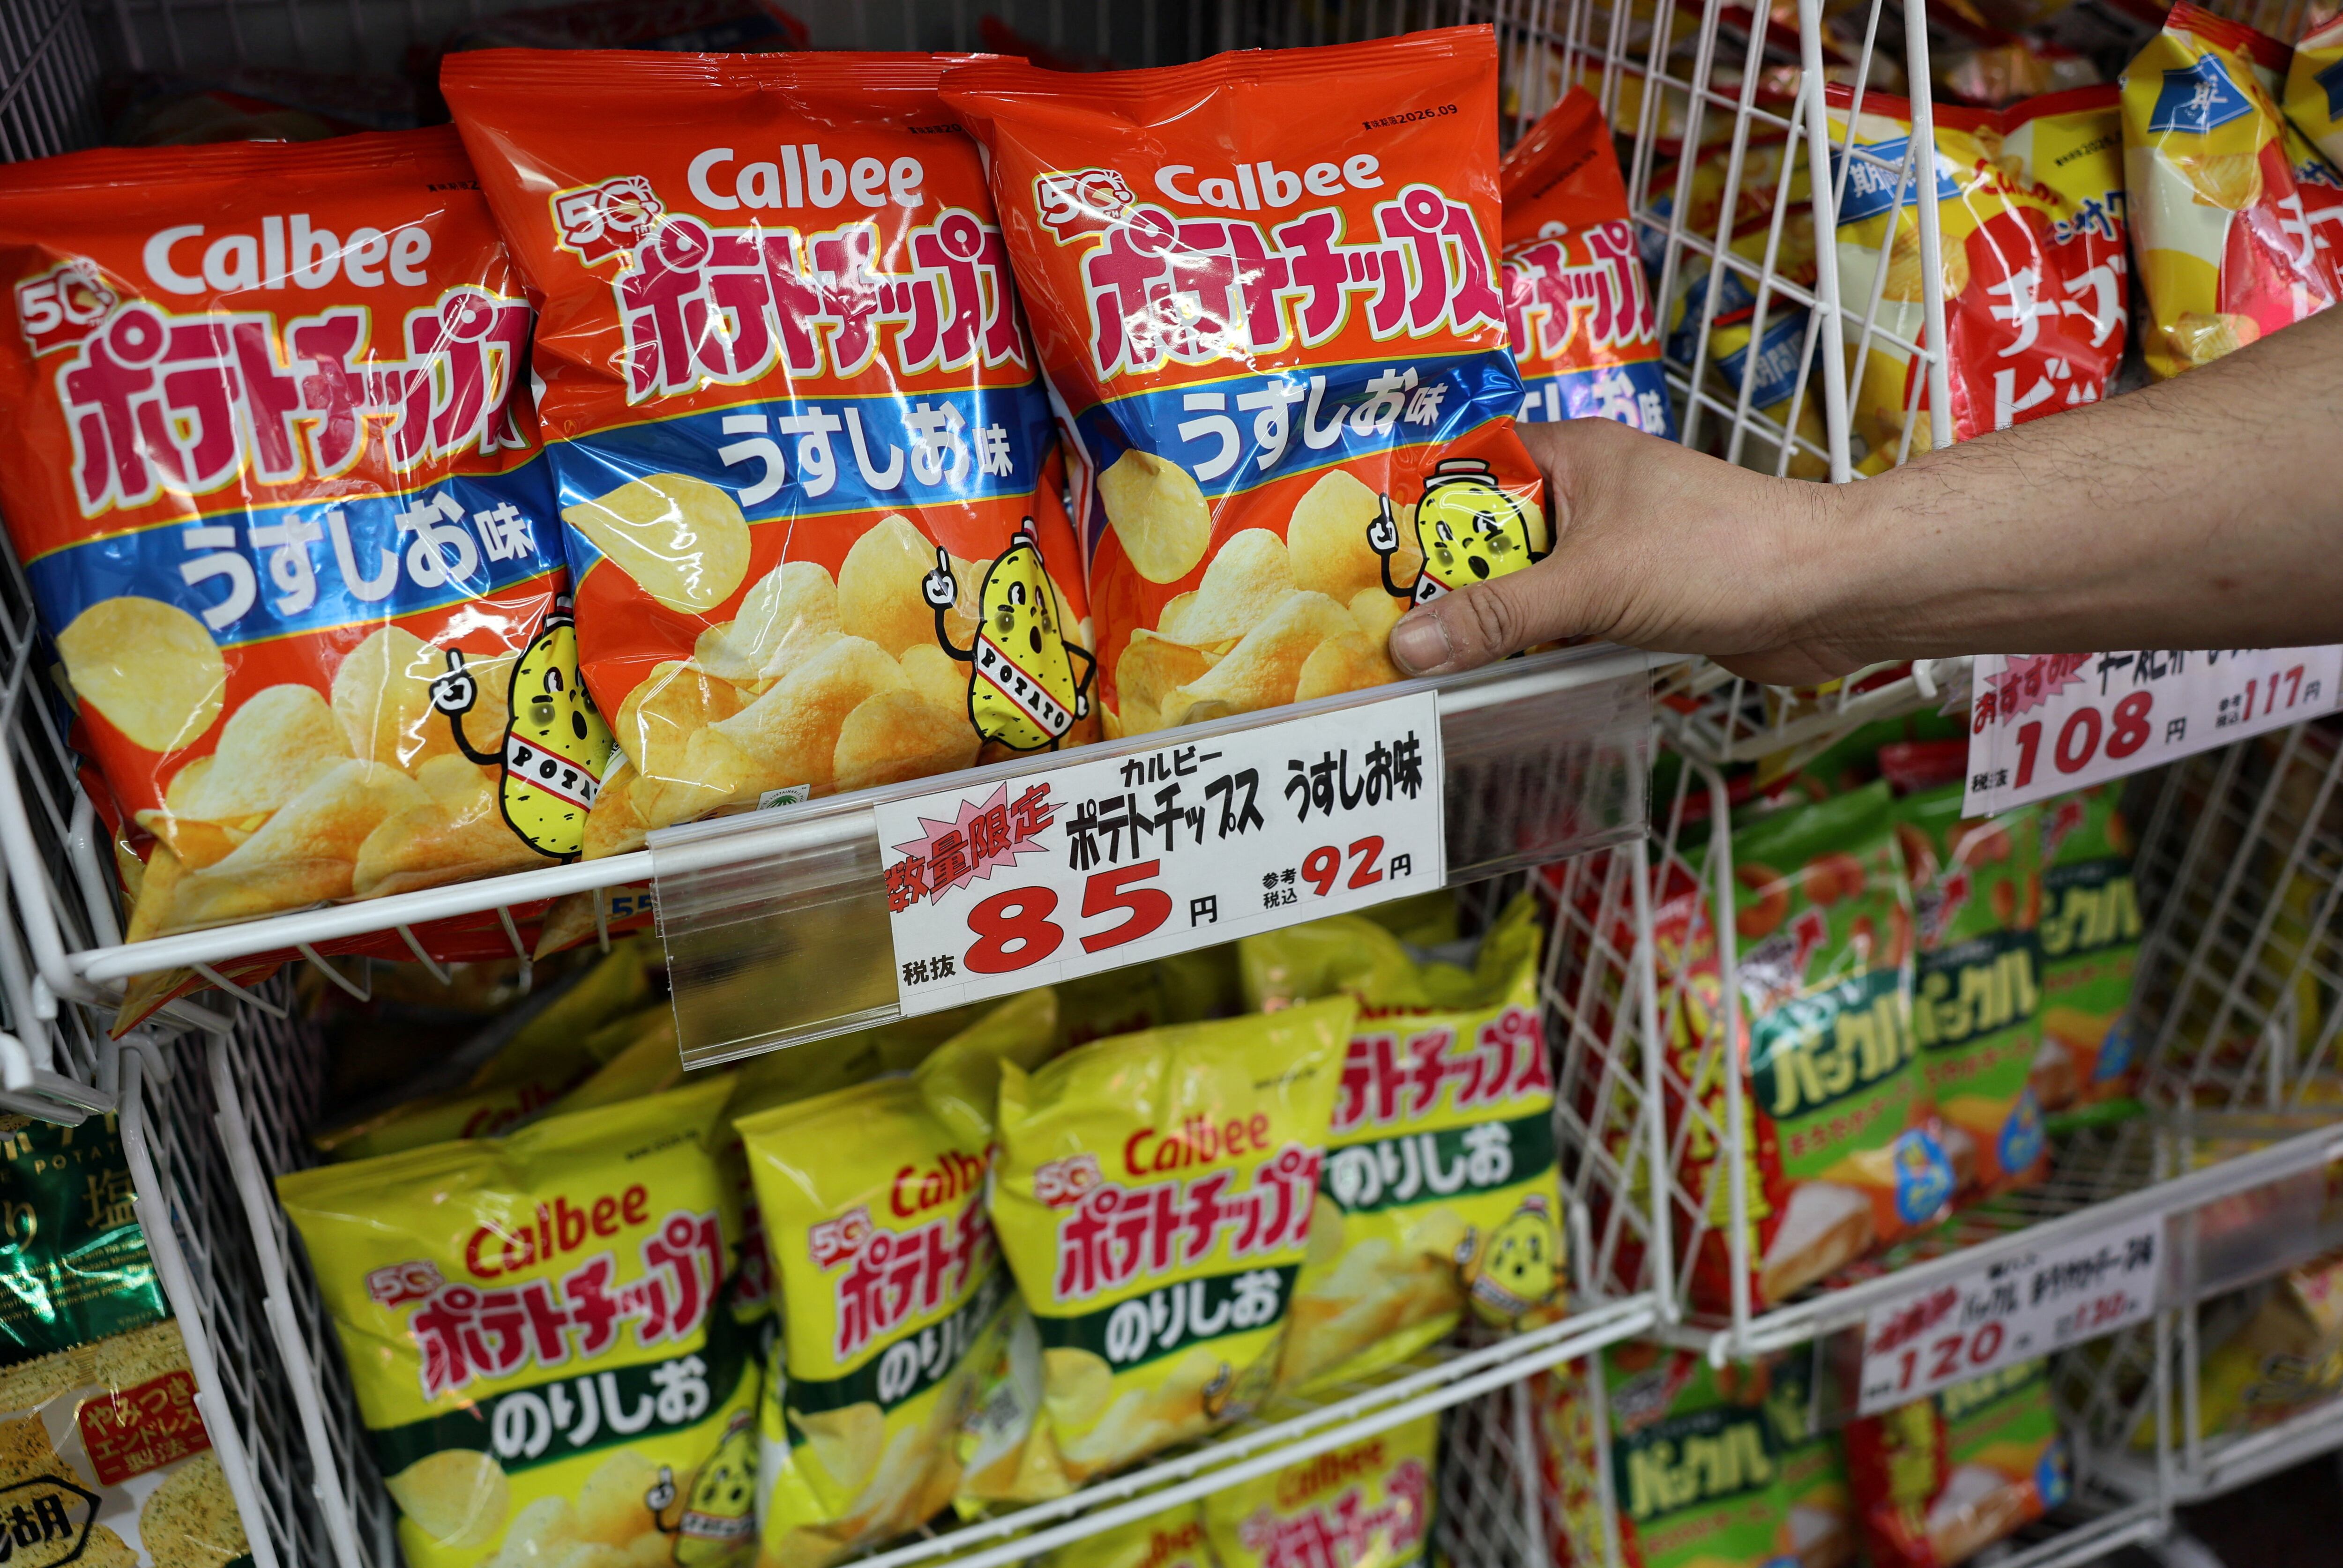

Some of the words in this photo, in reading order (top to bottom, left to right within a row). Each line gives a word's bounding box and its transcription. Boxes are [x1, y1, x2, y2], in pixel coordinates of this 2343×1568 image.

[1362, 104, 1458, 131] 賞味期限2026.09
[687, 144, 924, 210] Calbee
[1154, 153, 1384, 210] Calbee
[143, 214, 431, 294] Calbee
[1081, 184, 1507, 383] ポテトチップス
[612, 208, 1029, 404] ポテトチップス
[718, 400, 1013, 507] うすしお味
[1178, 366, 1448, 482] うすしお味
[180, 491, 536, 632] うすしお味
[981, 647, 1064, 728] POTATO
[2242, 665, 2305, 721] 117
[512, 746, 597, 801] POTA
[1120, 745, 1222, 787] カルビー
[2014, 691, 2153, 789] 108
[2165, 716, 2187, 745] 円
[1066, 768, 1264, 870] ポテトチップス
[1285, 730, 1422, 823] うすしお味
[884, 783, 1053, 913] 数量限定
[1262, 868, 1297, 890] 参考
[1301, 835, 1385, 896] 92
[1390, 854, 1411, 880] 円
[903, 954, 956, 986] 税抜
[963, 859, 1172, 973] 85
[1190, 895, 1217, 927] 円
[1263, 888, 1298, 910] 税込
[1330, 1004, 1553, 1131] テトチップス
[1124, 1114, 1269, 1176] Calbee
[1330, 1121, 1513, 1206] のりしお
[465, 1183, 649, 1280] Calbee
[835, 1199, 992, 1362] ポテトチ
[1104, 1270, 1283, 1363] のりしお
[1898, 1321, 2004, 1391] 120
[86, 1376, 190, 1438] やみつき
[95, 1405, 201, 1462] エンドレス
[492, 1356, 709, 1459] のりしお
[0, 1493, 74, 1564] 湖
